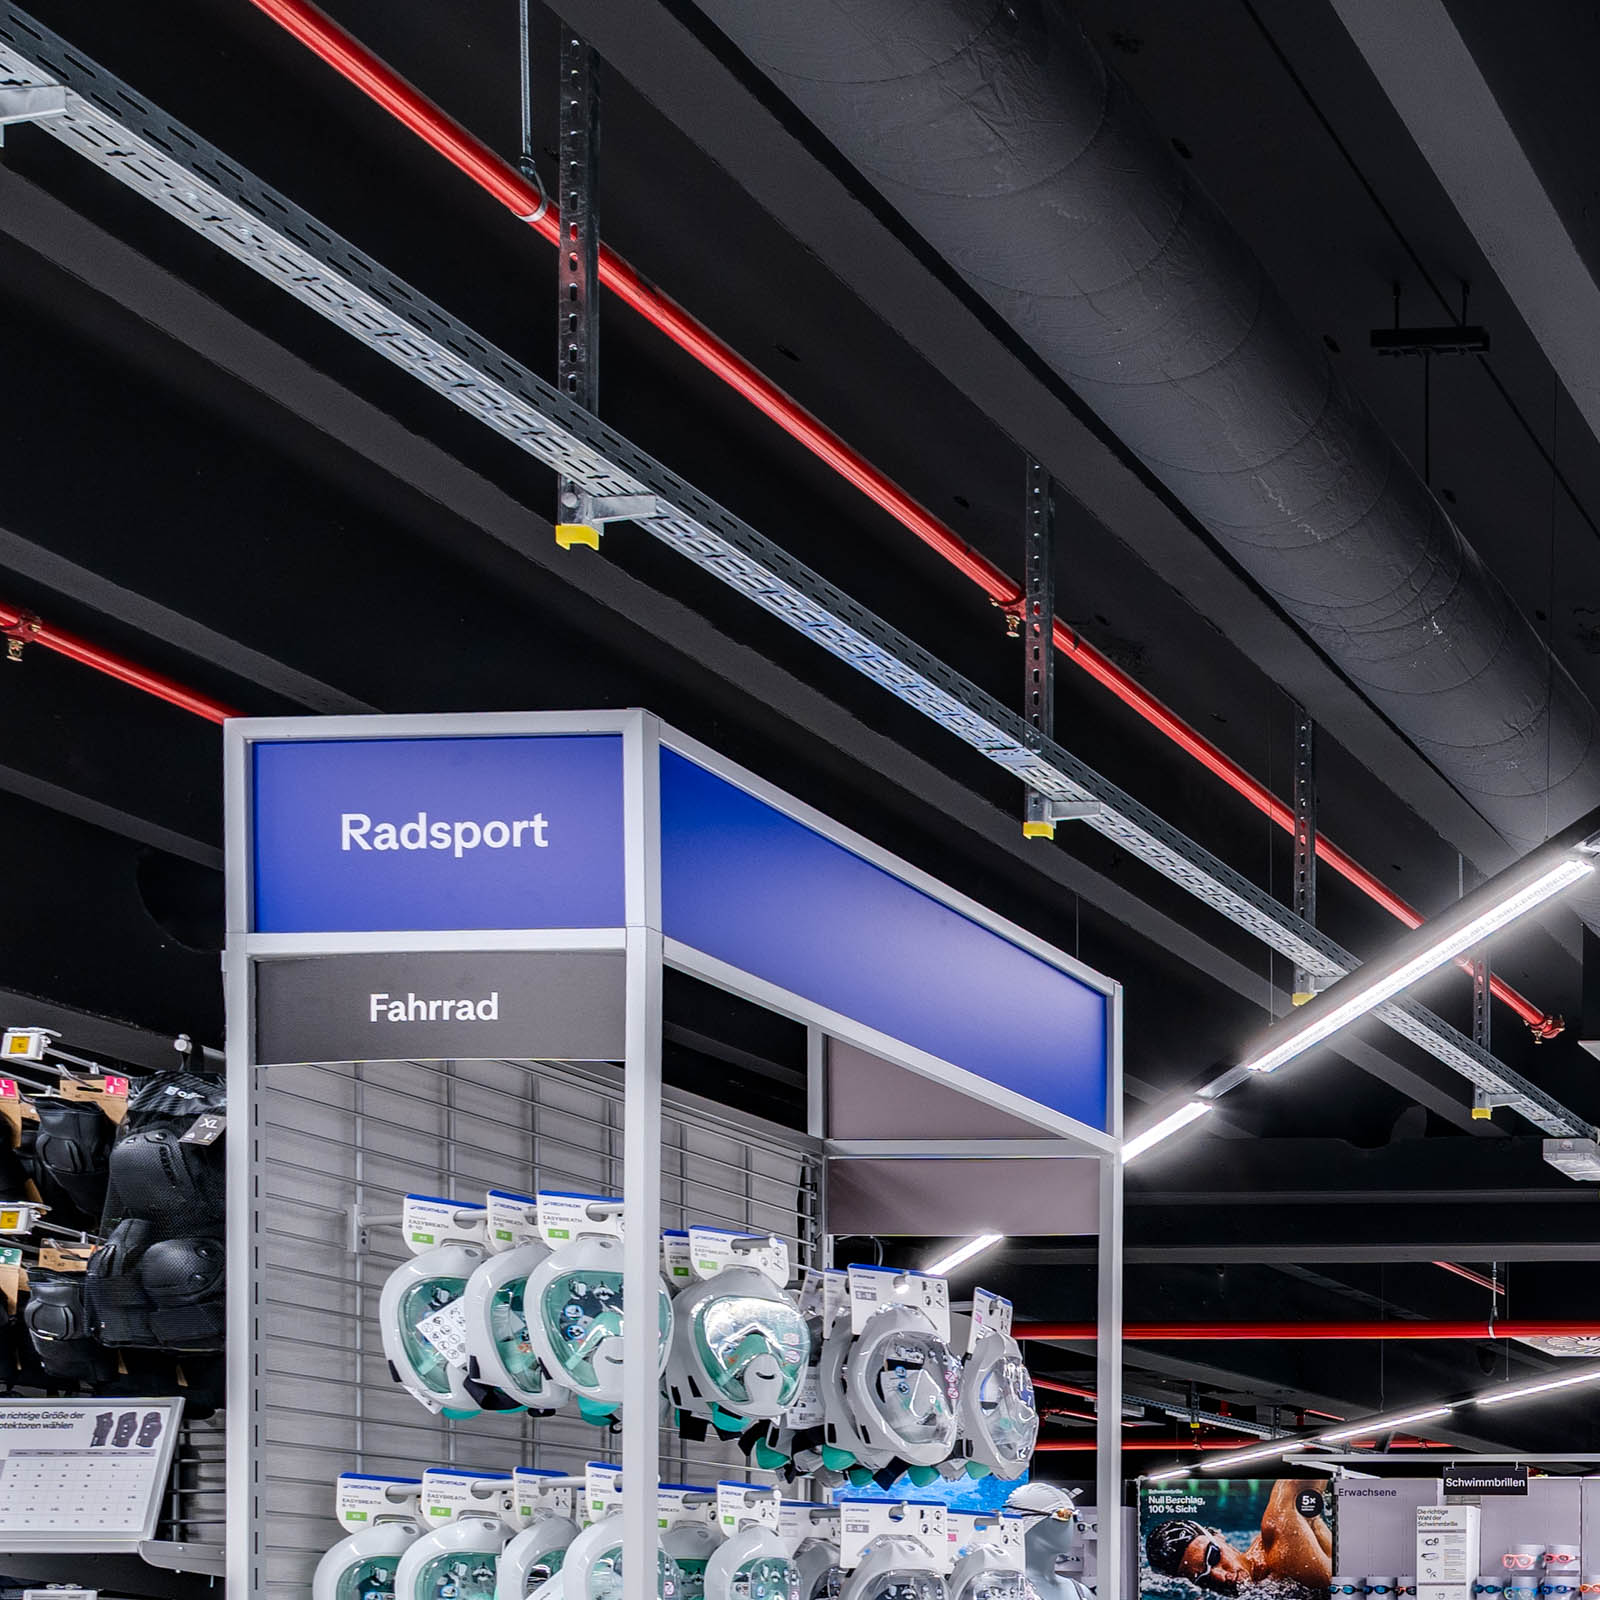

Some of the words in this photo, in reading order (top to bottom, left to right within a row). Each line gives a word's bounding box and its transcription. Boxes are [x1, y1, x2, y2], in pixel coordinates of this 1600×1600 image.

[341, 811, 549, 857] Radsport
[370, 992, 499, 1023] Fahrrad
[200, 1119, 218, 1128] XL
[7, 1411, 40, 1421] richtige
[41, 1411, 69, 1419] Größe
[70, 1411, 86, 1419] der
[43, 1421, 74, 1429] wählen
[1445, 1478, 1526, 1488] Schwimmbrillen
[1338, 1487, 1397, 1497] Erwachsene
[1148, 1496, 1166, 1504] Null
[1166, 1496, 1206, 1506] Beschlag,
[1149, 1505, 1164, 1513] 100
[1165, 1505, 1174, 1513] %
[1175, 1505, 1197, 1513] Sicht
